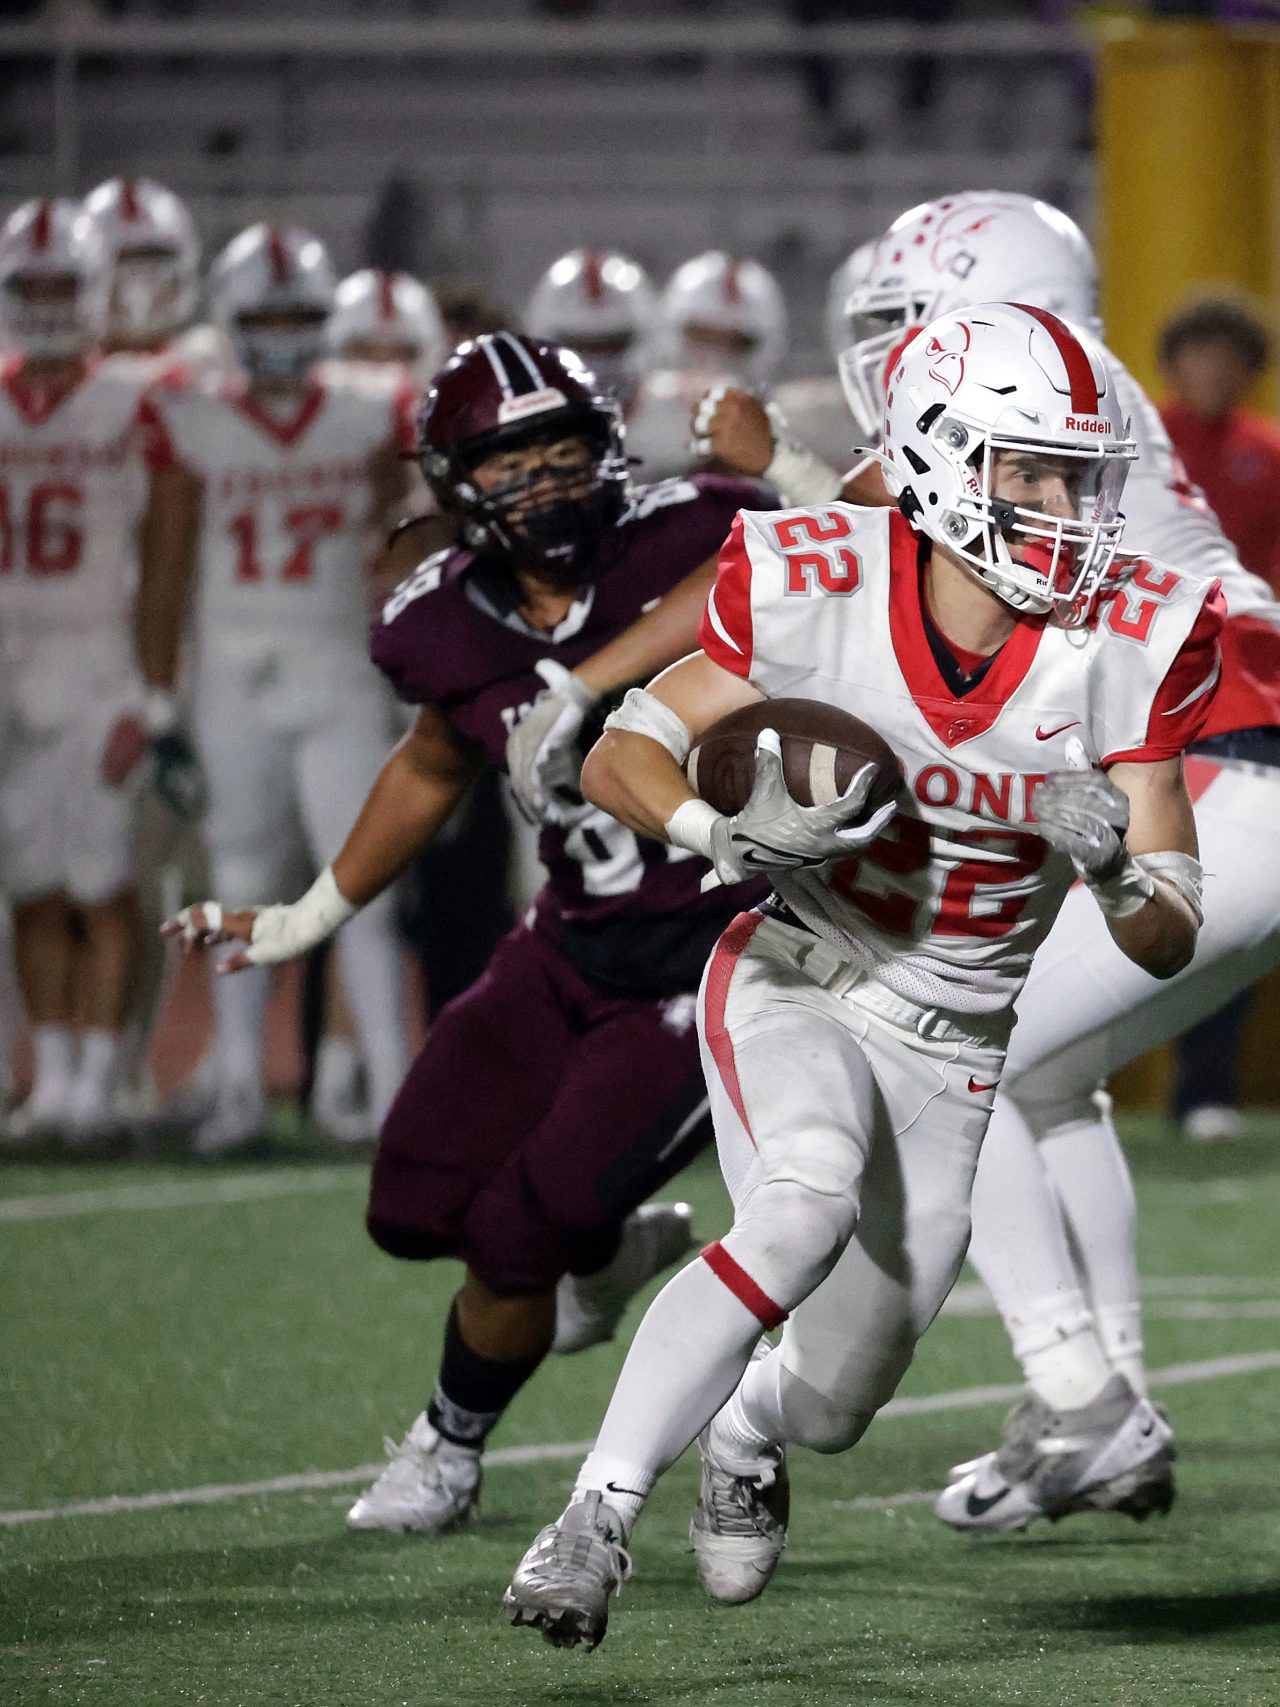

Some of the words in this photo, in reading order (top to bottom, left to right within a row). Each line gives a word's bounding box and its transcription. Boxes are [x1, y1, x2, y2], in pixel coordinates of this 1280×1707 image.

[1065, 416, 1112, 434] Riddell
[229, 505, 344, 581] 17
[769, 510, 864, 598] 22
[828, 812, 1046, 939] 22
